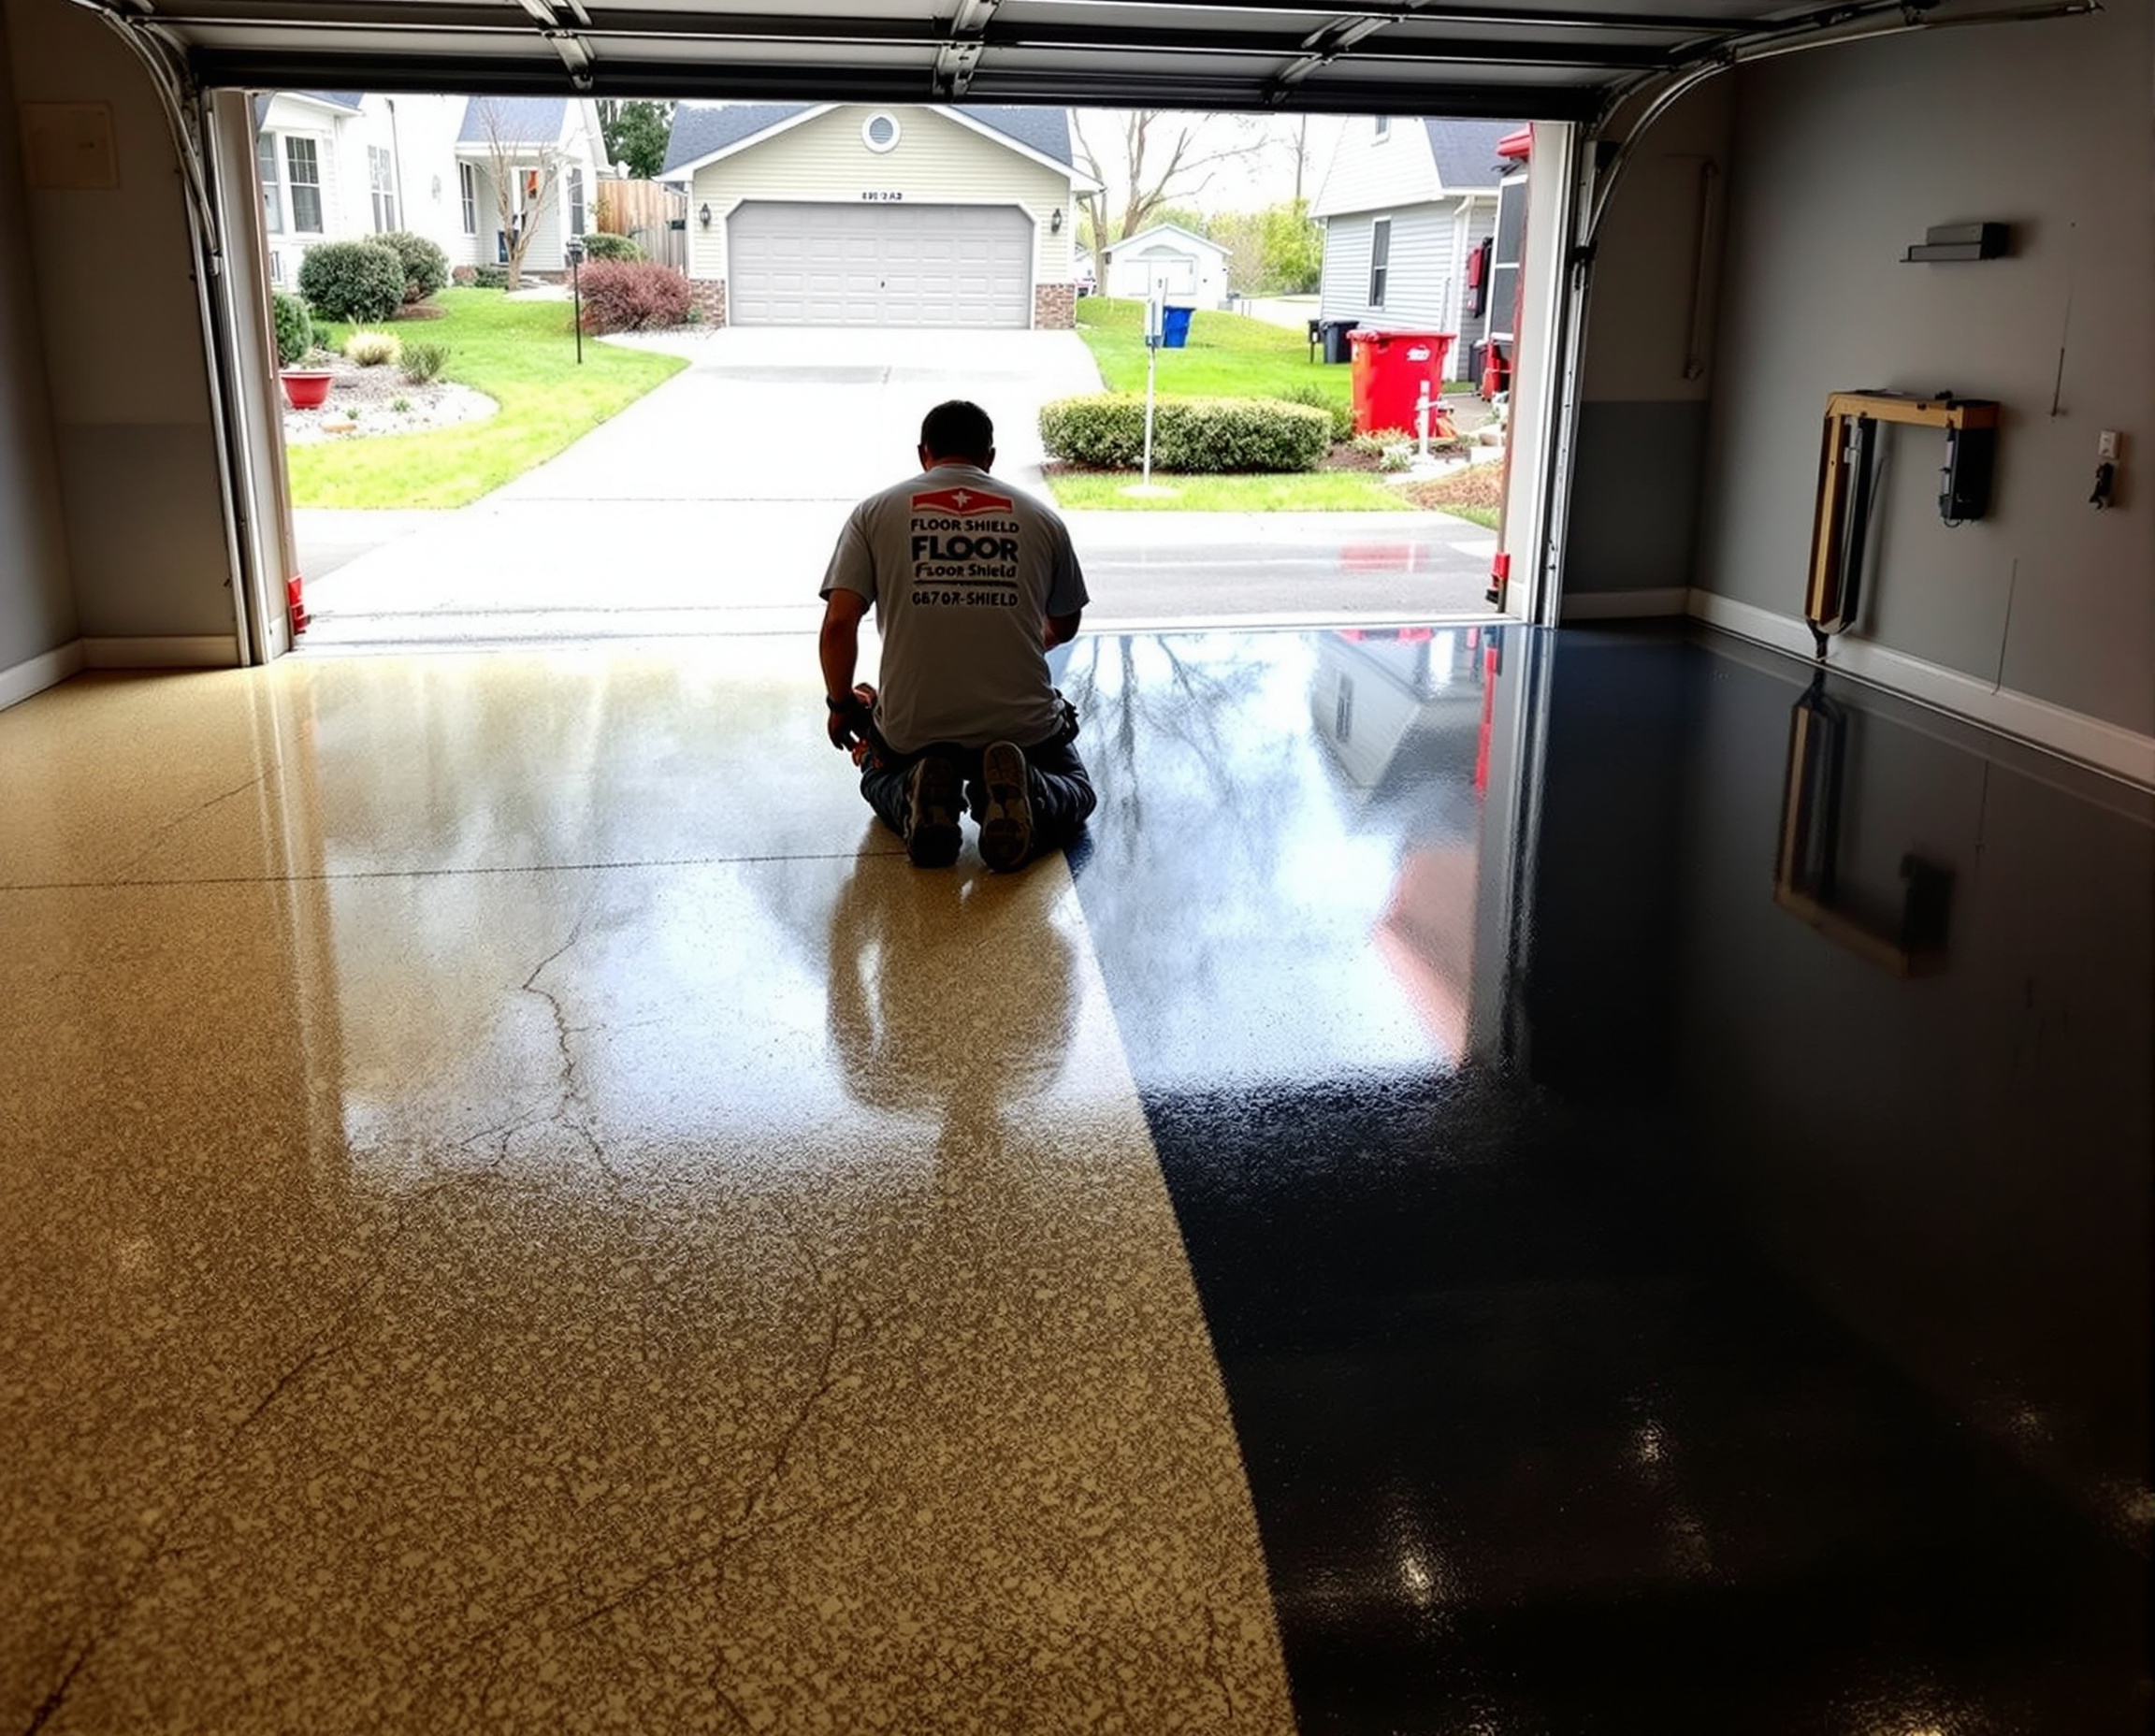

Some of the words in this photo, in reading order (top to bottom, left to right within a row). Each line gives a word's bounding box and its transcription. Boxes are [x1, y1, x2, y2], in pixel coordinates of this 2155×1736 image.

[911, 518, 961, 531] FLOOR
[964, 520, 1020, 533] SHIELD
[912, 535, 1019, 563] FLOOR
